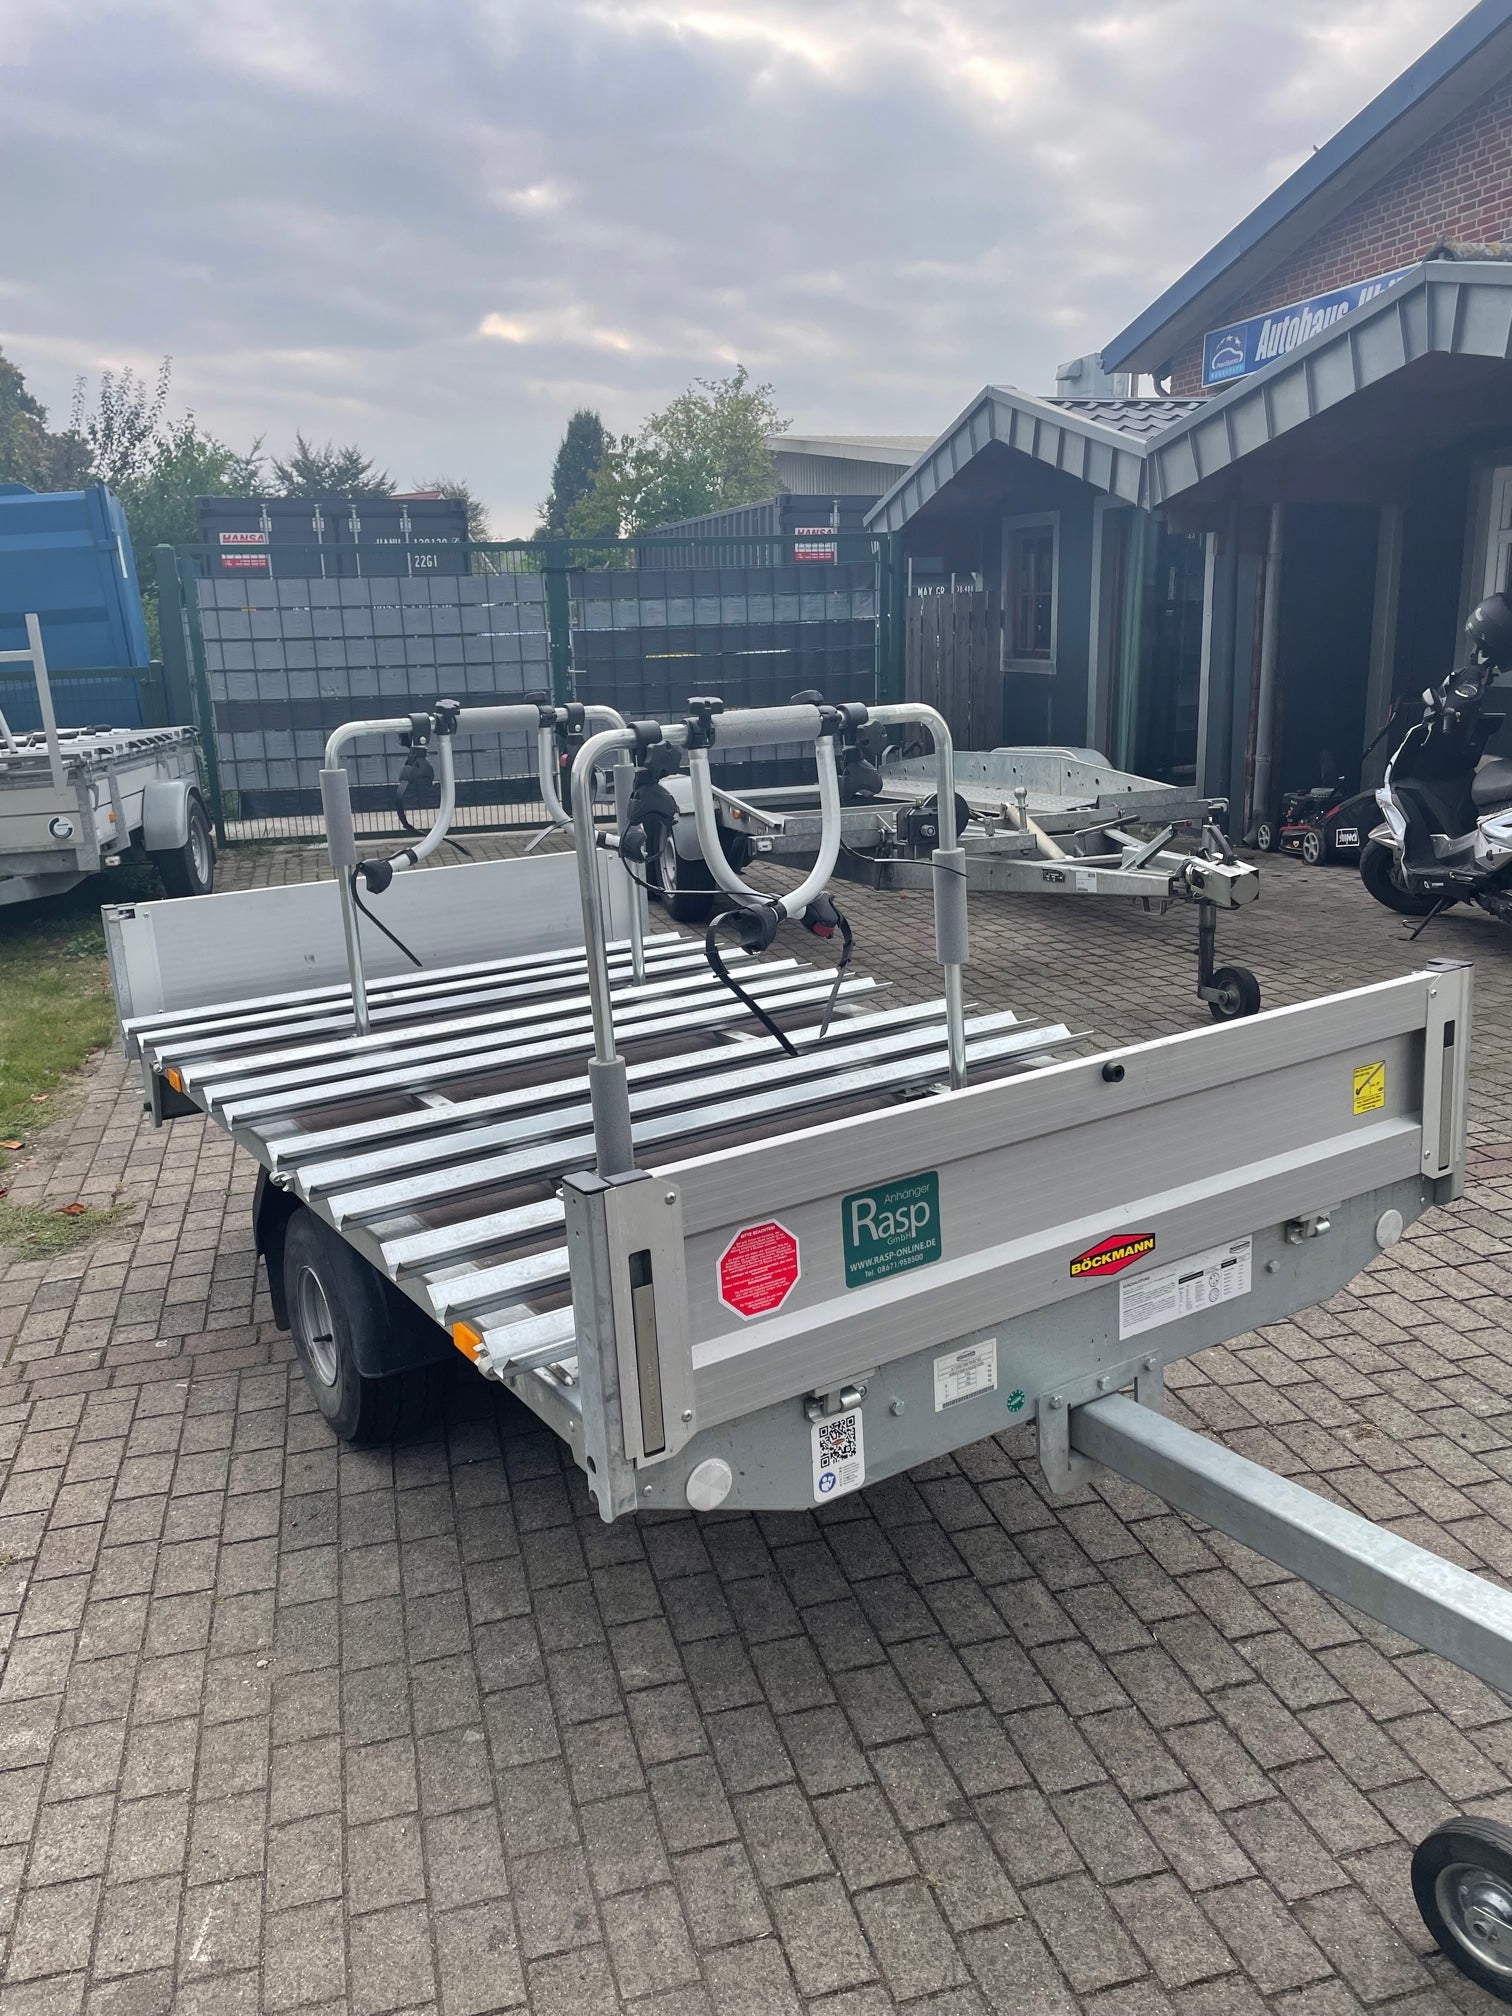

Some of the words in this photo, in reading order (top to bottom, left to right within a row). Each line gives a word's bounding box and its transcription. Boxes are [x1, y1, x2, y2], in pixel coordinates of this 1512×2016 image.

[851, 1197, 931, 1247] Rasp
[886, 1231, 912, 1245] GmbH
[849, 1238, 937, 1272] WWW.RASP-ONLINE.DE
[1071, 1238, 1154, 1275] BÖCKMANN
